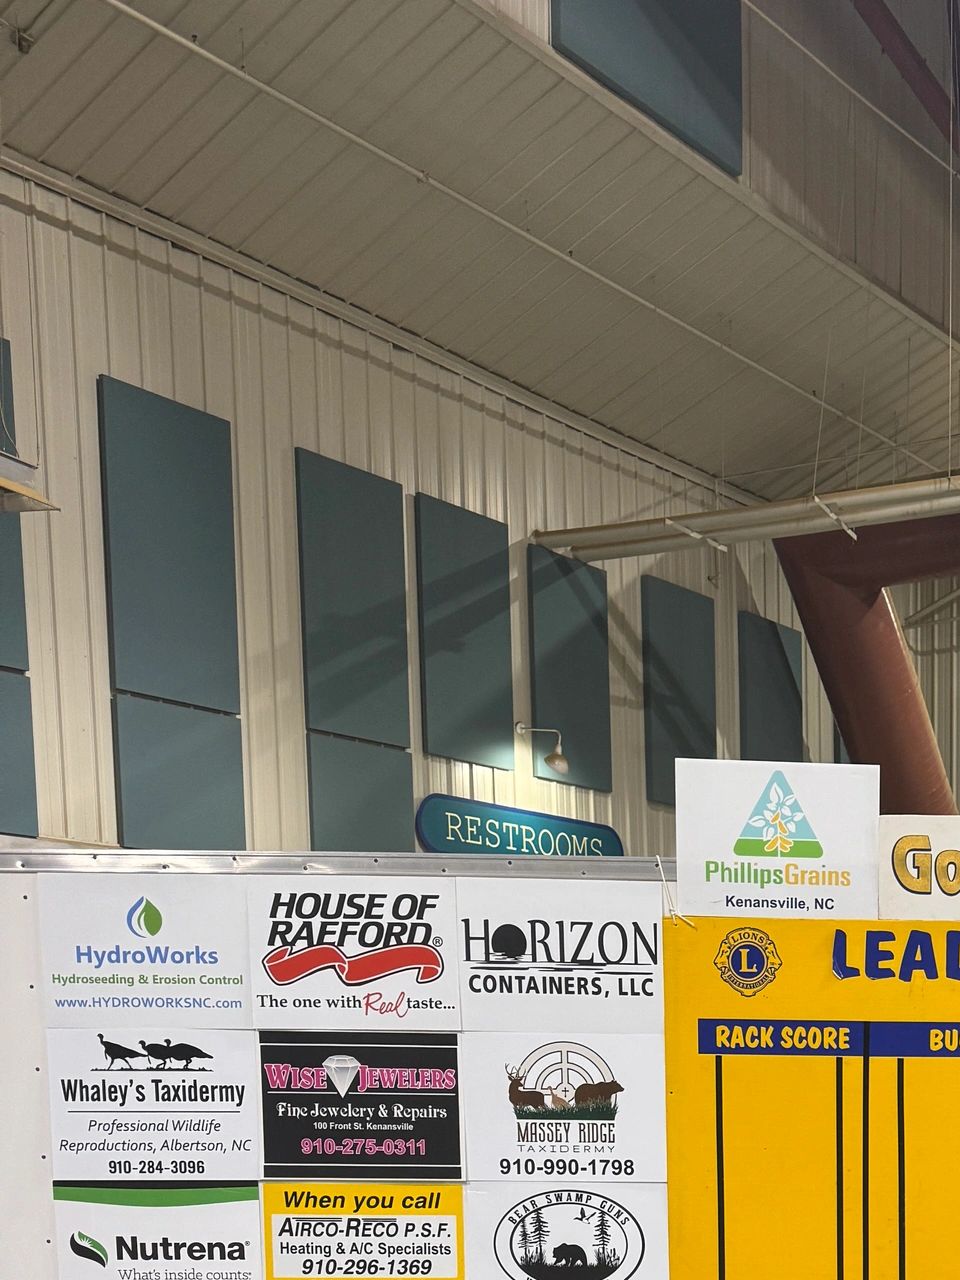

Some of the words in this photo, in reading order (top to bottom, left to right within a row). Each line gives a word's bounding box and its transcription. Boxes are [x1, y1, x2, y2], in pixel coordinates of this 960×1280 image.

[445, 812, 602, 856] RESTROOMS
[269, 893, 387, 919] HOUSE
[392, 894, 439, 920] OF
[726, 896, 809, 911] Kenansville,
[814, 899, 834, 909] NC
[268, 921, 432, 947] RAEFORD
[731, 932, 765, 943] LIONS
[76, 945, 218, 968] HydroWorks
[469, 974, 610, 998] CONTAINERS,
[618, 978, 654, 996] LLC
[55, 997, 242, 1009] www.HYDROWORKSNC.com
[716, 1025, 773, 1049] RACK
[780, 1026, 850, 1050] SCORE
[264, 1064, 327, 1088] WISE
[358, 1065, 456, 1092] JEWELERS
[61, 1079, 146, 1106] Whaley's
[151, 1079, 245, 1107] Taxidermy
[88, 1119, 168, 1133] Professional
[171, 1120, 221, 1133] Wildlife
[313, 1122, 327, 1130] 100
[330, 1122, 351, 1130] Front
[353, 1122, 364, 1130] St.
[367, 1122, 413, 1131] Kenansville
[517, 1122, 570, 1143] MASSEY
[579, 1123, 615, 1143] RIDGE
[59, 1139, 156, 1153] Reproductions,
[160, 1139, 228, 1153] Albertson,
[231, 1140, 251, 1152] NC
[301, 1138, 426, 1155] 910-275-0311
[517, 1145, 615, 1153] TAXIDERMY
[108, 1161, 205, 1174] 910-284-3096
[500, 1159, 635, 1175] 910-990-1798
[284, 1191, 345, 1208] When
[353, 1195, 394, 1213] you
[401, 1192, 440, 1209] call
[405, 1223, 451, 1238] P.S.F.
[116, 1236, 245, 1261] Nutrena
[280, 1242, 331, 1257] Heating
[336, 1243, 345, 1254] &
[350, 1243, 373, 1255] A/C
[378, 1243, 451, 1257] Specialists
[302, 1259, 432, 1275] 910-296-1369
